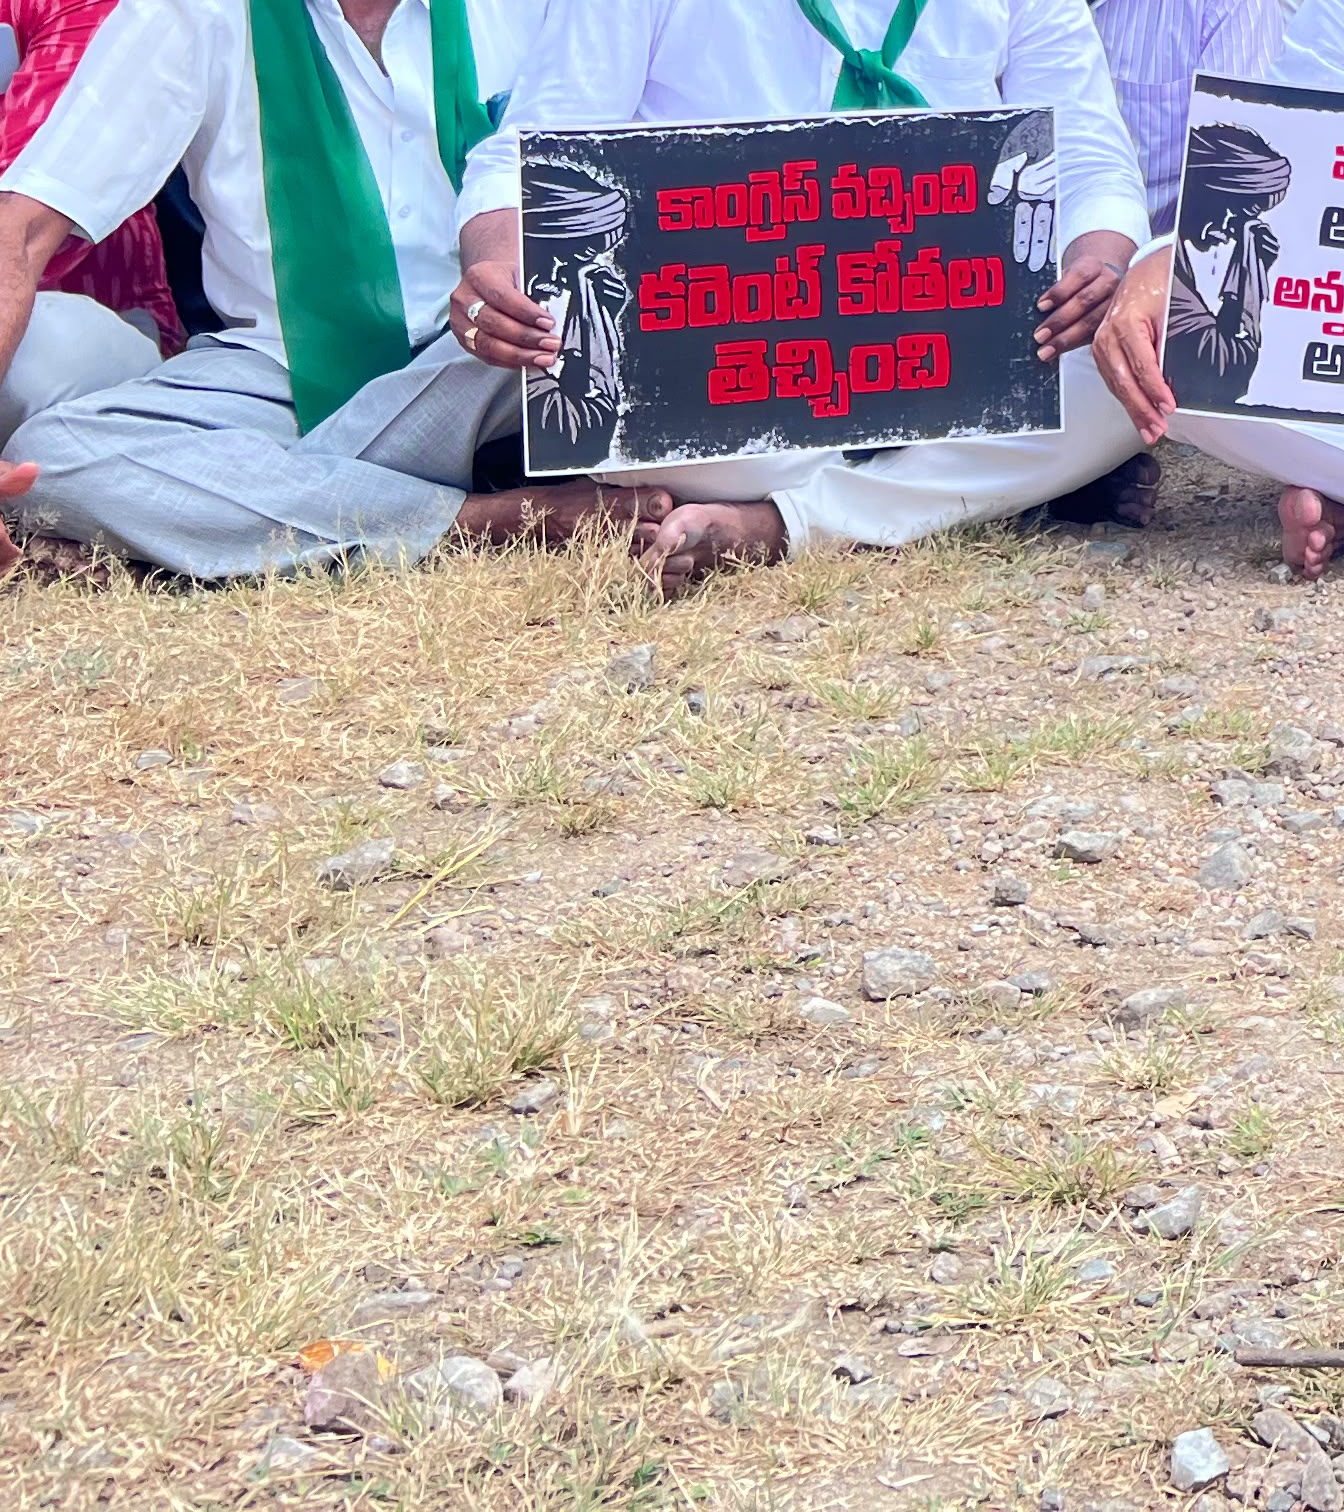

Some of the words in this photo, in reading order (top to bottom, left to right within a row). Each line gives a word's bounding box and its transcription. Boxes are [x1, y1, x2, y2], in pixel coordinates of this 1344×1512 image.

[657, 160, 821, 243] కాంగ్రెస్
[638, 244, 826, 332] కరెంట్
[836, 239, 1005, 316] కోతలు
